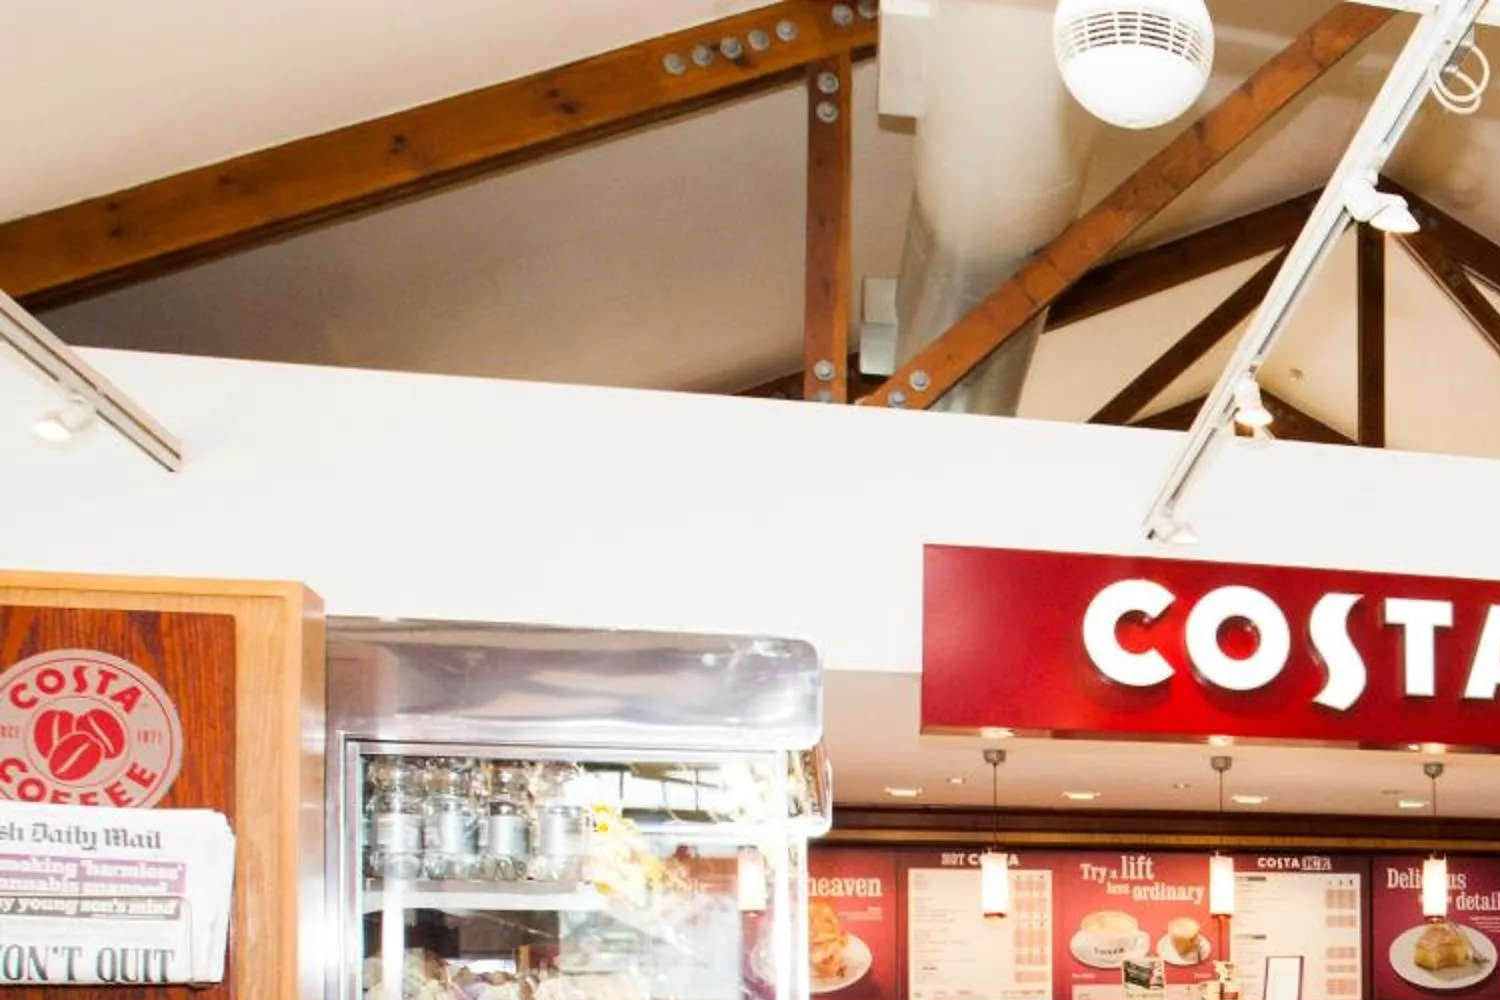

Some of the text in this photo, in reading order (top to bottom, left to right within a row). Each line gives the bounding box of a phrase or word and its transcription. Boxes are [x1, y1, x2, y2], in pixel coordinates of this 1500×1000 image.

[10, 665, 142, 715] COSTA
[0, 758, 158, 807] COFFEE
[32, 823, 97, 850] Daily
[104, 828, 161, 849] Mail
[1079, 863, 1108, 884] Try
[1119, 855, 1155, 881] lift
[1257, 857, 1300, 870] COSTA
[1386, 867, 1468, 889] Delius
[1132, 881, 1205, 905] ordinary
[0, 944, 175, 983] ON'T QUIT
